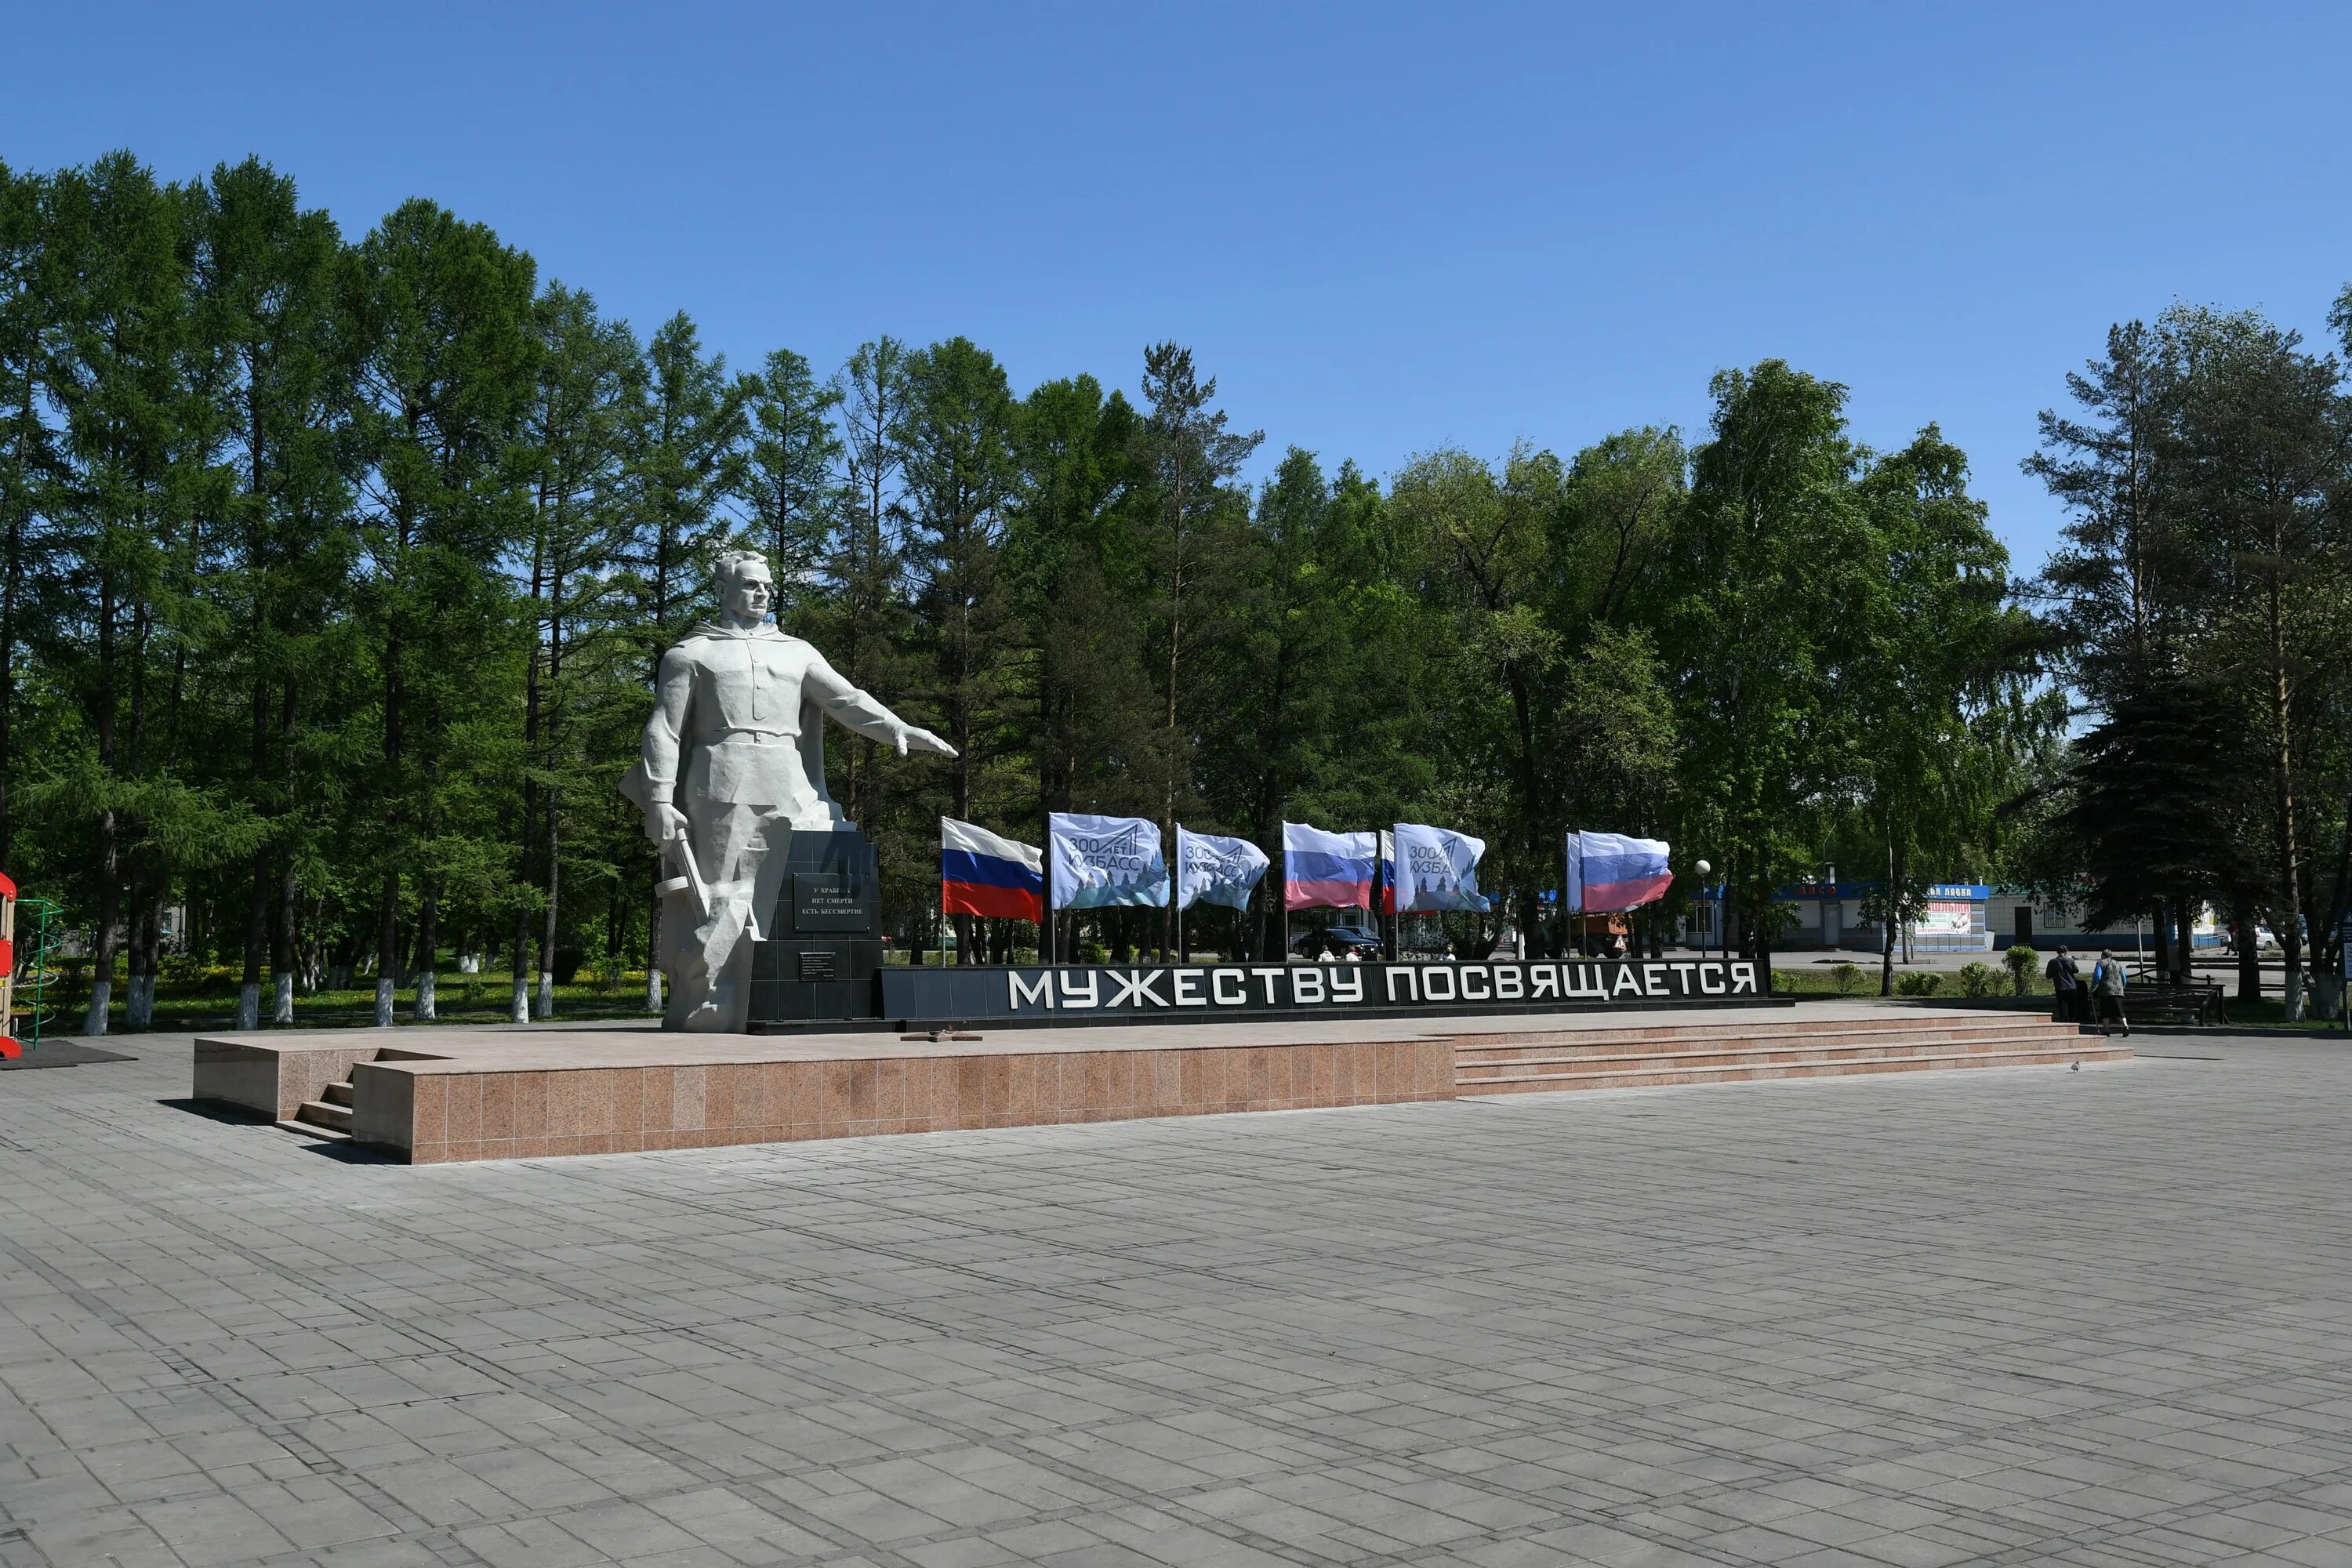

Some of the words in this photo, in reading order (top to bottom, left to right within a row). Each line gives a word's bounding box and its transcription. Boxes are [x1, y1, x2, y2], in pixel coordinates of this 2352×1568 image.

[1069, 838, 1099, 853] 300
[1410, 846, 1436, 859] 300
[1069, 854, 1140, 871] КУЗБАСС
[1944, 887, 1971, 897] ЛАВКА
[1927, 901, 1969, 912] ШЛЫКИ
[1008, 967, 1363, 1009] МУЖЕСТВУ
[1385, 962, 1757, 1001] ПОСВЯЩАЕТСЯ
